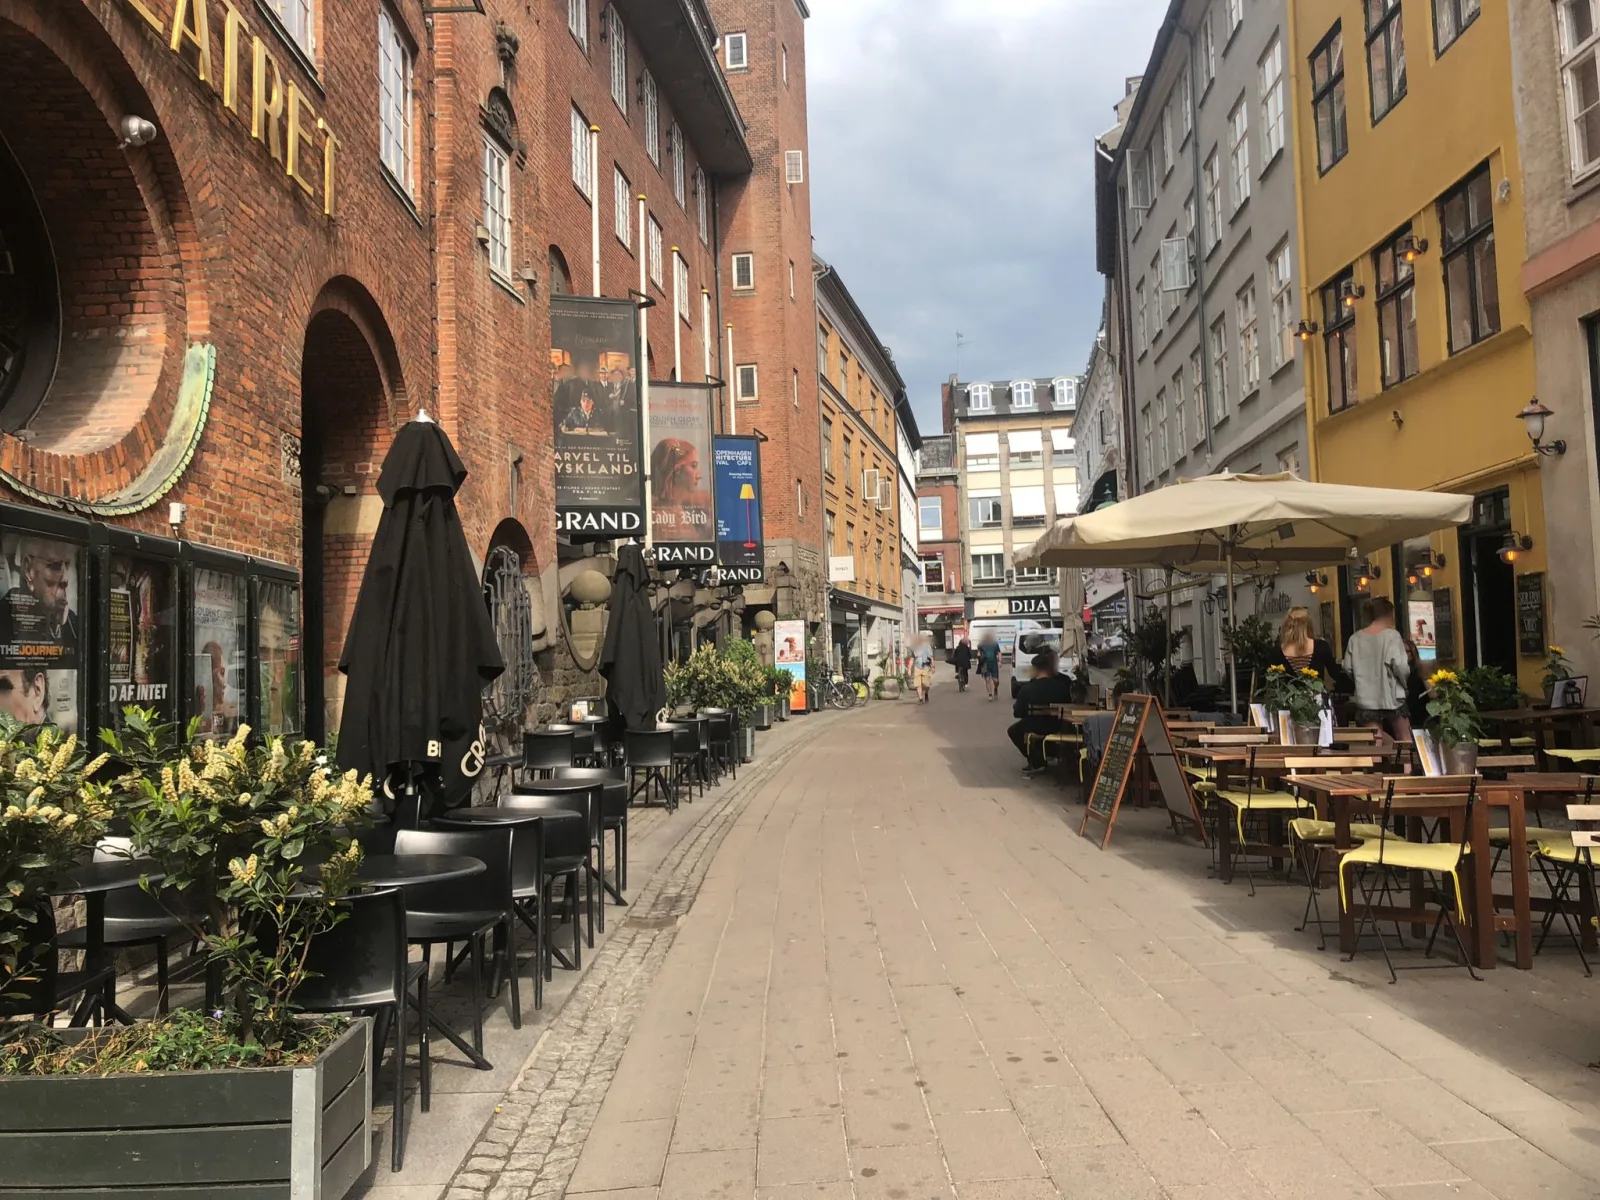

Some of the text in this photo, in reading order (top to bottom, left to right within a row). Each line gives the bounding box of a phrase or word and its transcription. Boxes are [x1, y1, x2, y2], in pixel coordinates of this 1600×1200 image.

[128, 0, 342, 217] ATRET
[554, 452, 630, 462] ARVEL TIL
[681, 509, 707, 525] Bird
[1011, 599, 1048, 613] DIJA
[119, 684, 136, 702] AF
[137, 683, 168, 701] INTET
